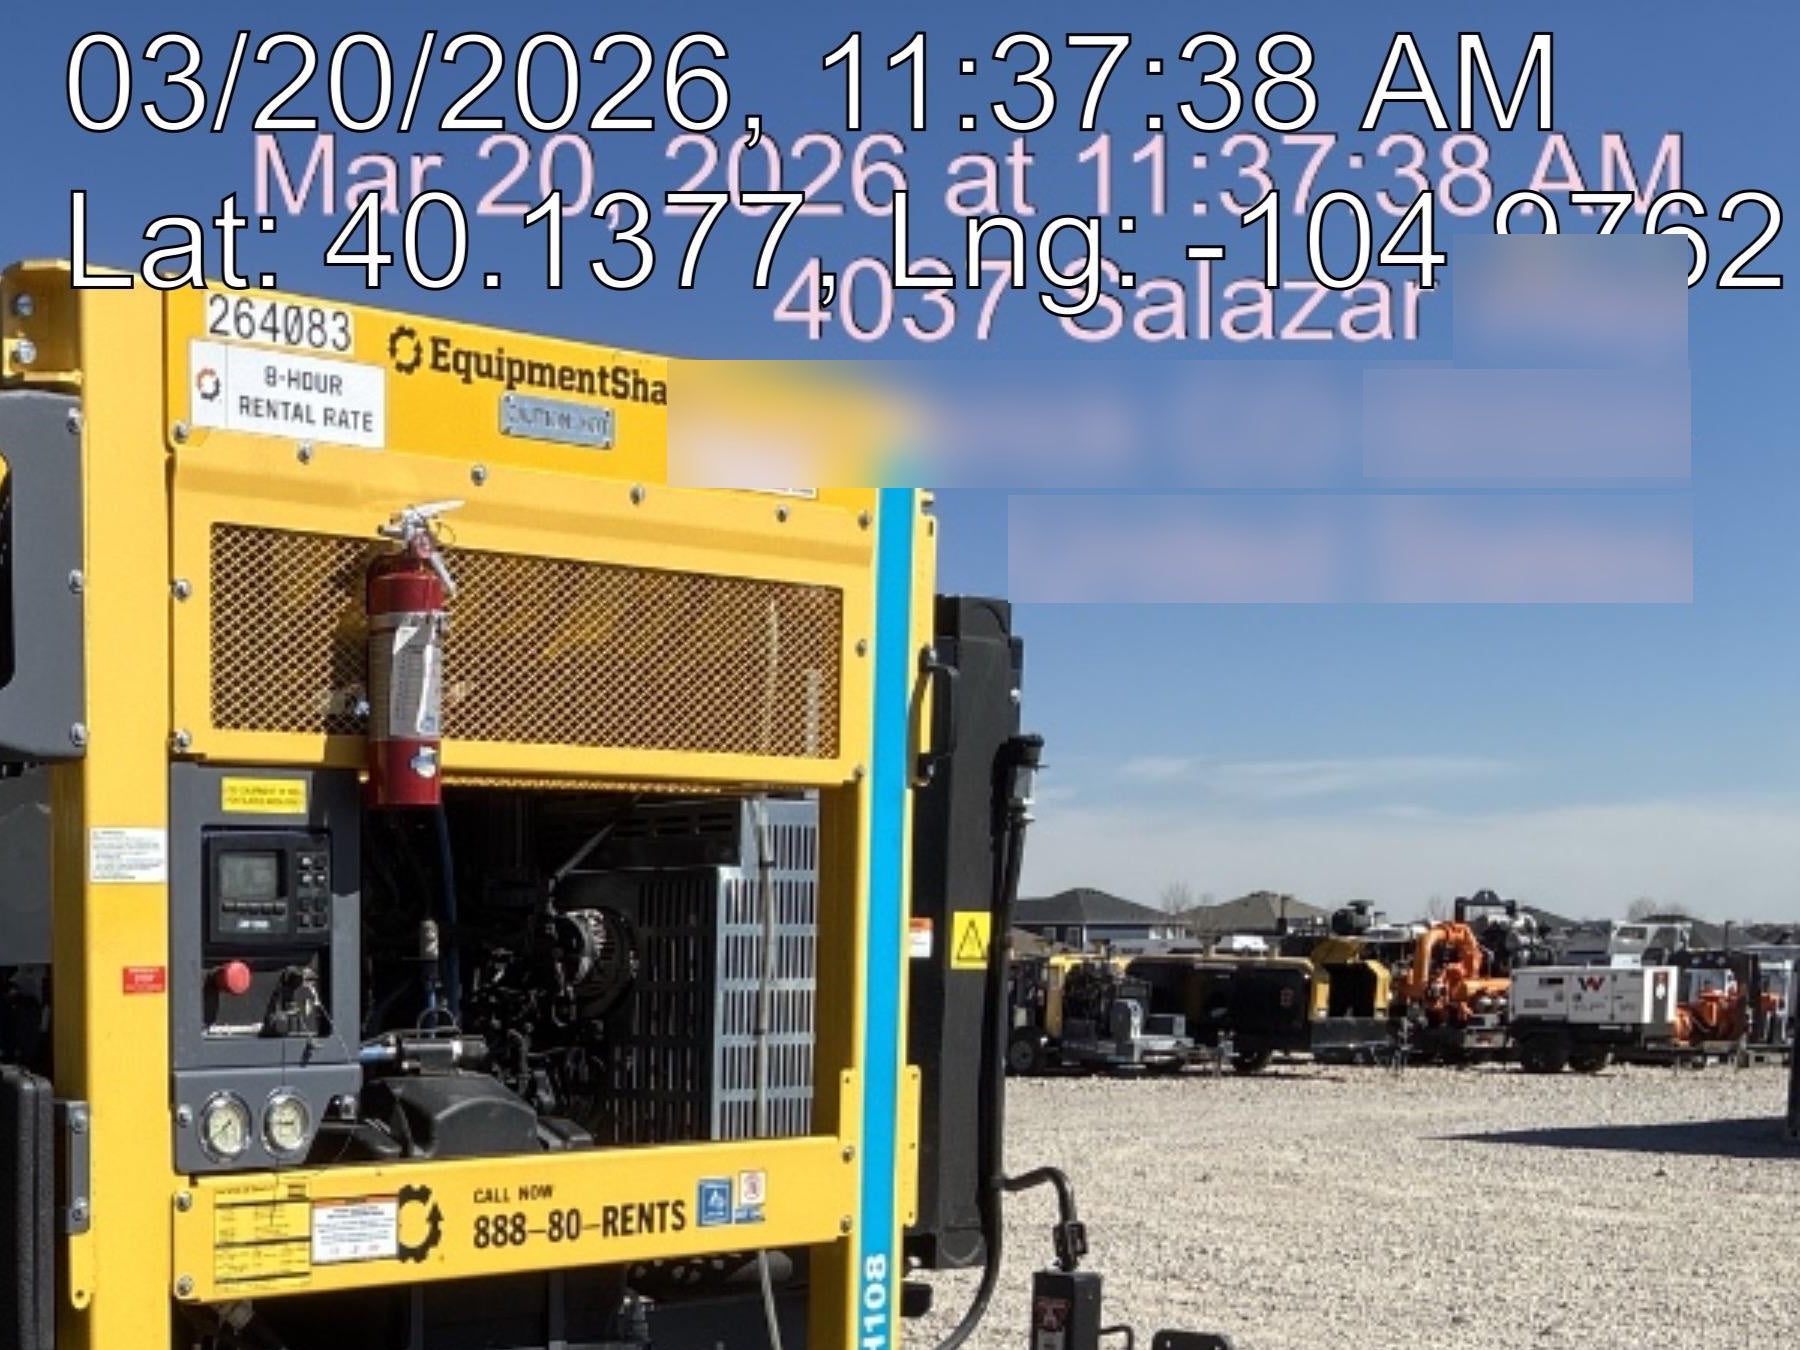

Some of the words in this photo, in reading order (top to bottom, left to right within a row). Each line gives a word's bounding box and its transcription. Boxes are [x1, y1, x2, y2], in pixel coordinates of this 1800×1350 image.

[208, 294, 352, 351] 264083
[264, 365, 343, 396] 8-HOUR
[238, 395, 316, 426] RENTAL
[323, 406, 374, 433] RATE
[473, 1188, 510, 1203] CALL
[518, 1184, 553, 1201] NOW
[473, 1200, 686, 1249] 888-80-RENTS
